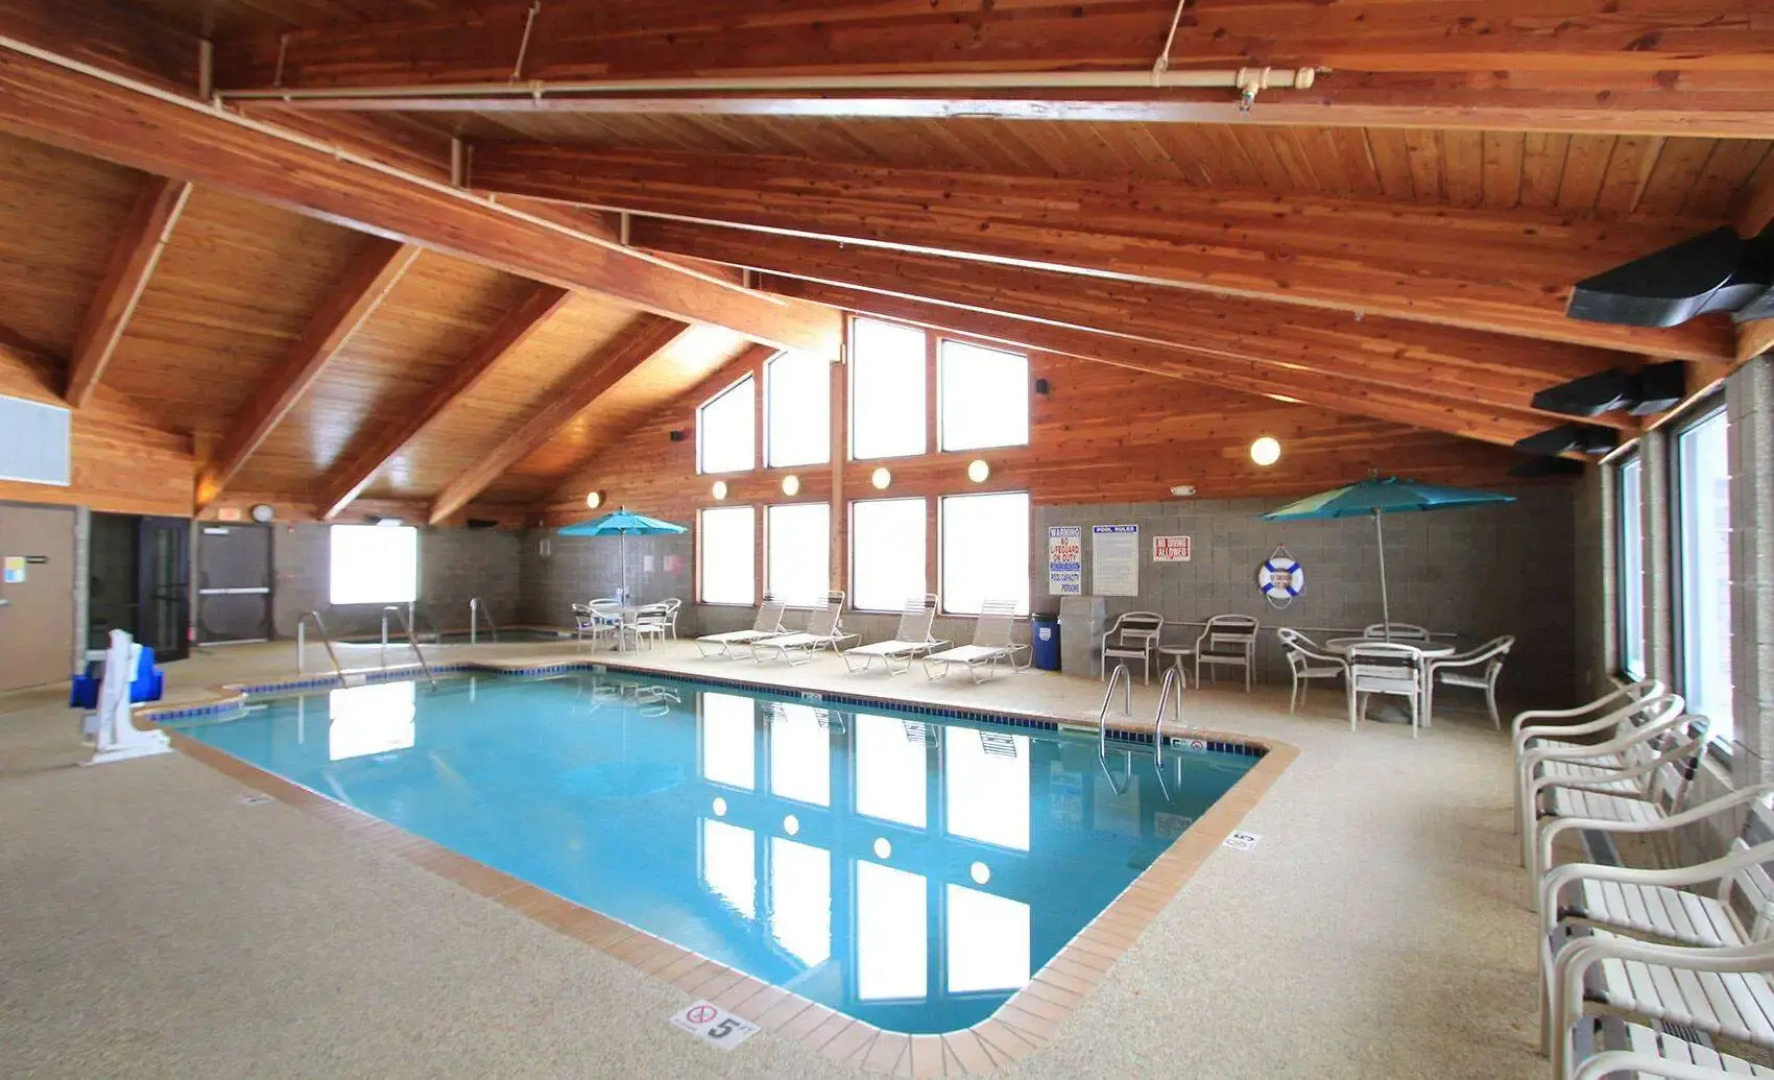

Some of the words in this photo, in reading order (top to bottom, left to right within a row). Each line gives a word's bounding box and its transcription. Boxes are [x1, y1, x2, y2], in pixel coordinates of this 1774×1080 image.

[1050, 528, 1081, 538] WARNING
[1061, 538, 1069, 546] NO
[1051, 545, 1079, 554] LIFEGUARD
[1053, 554, 1061, 562] ON
[1062, 553, 1077, 562] DUTY
[1061, 573, 1080, 582] CAPACITY
[1062, 584, 1079, 593] PERSONS
[708, 1018, 740, 1039] 5
